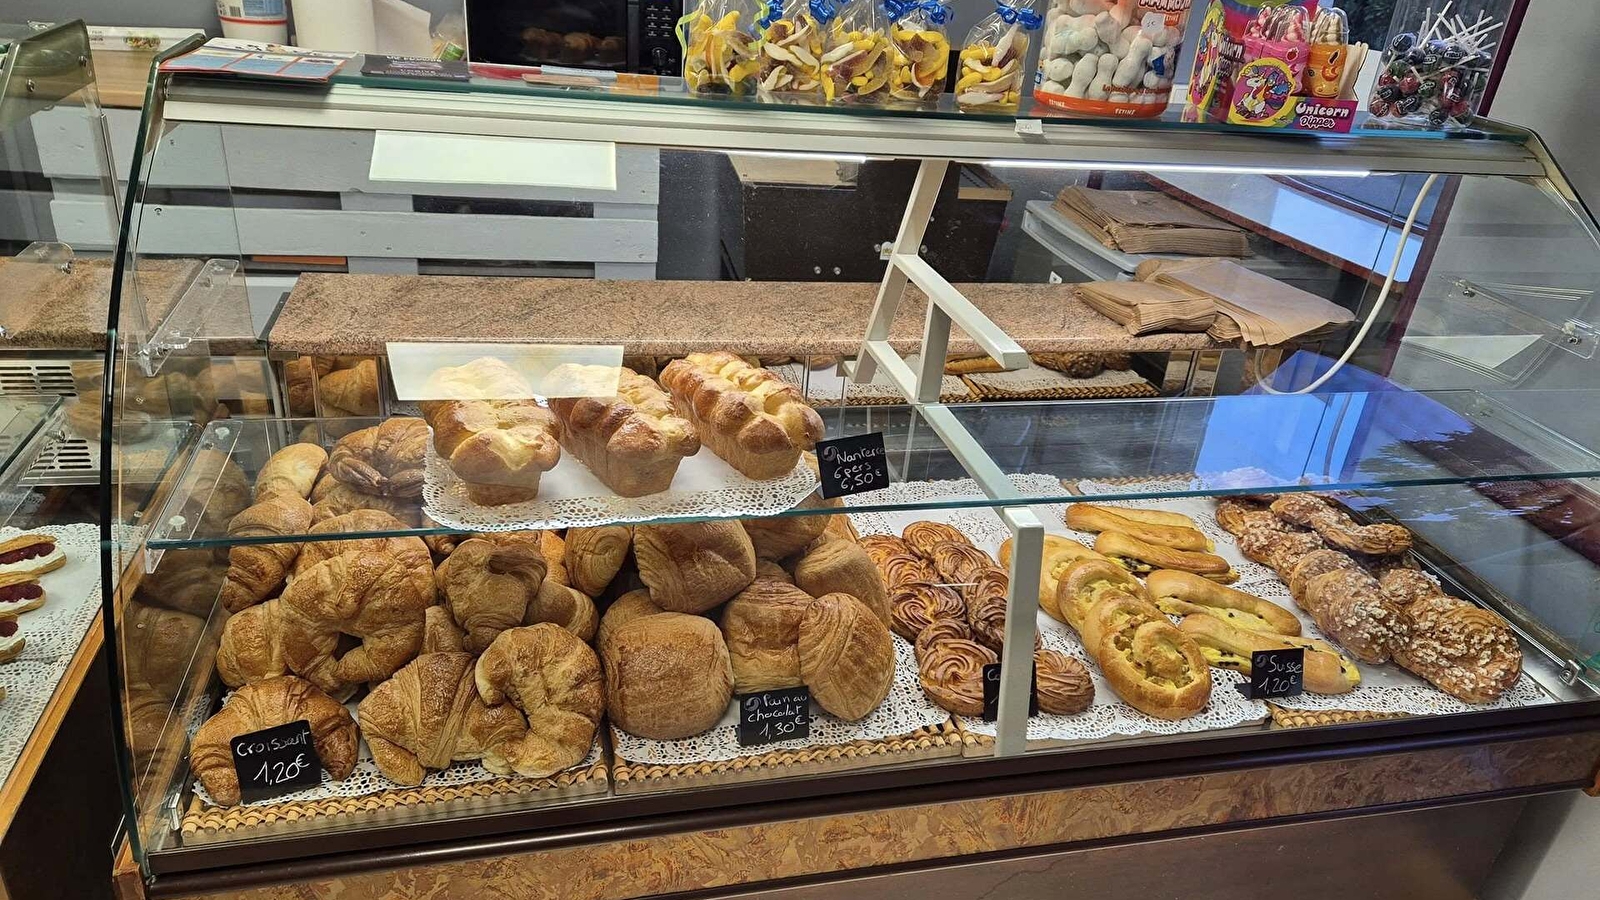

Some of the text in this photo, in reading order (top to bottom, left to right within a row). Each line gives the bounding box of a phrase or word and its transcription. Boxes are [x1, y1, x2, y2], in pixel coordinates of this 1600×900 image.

[1295, 102, 1350, 118] Unicorn
[1299, 115, 1336, 129] Dipper
[1258, 675, 1298, 695] 1,20€
[759, 714, 806, 740] 1,30€
[253, 753, 311, 786] 1,20€
